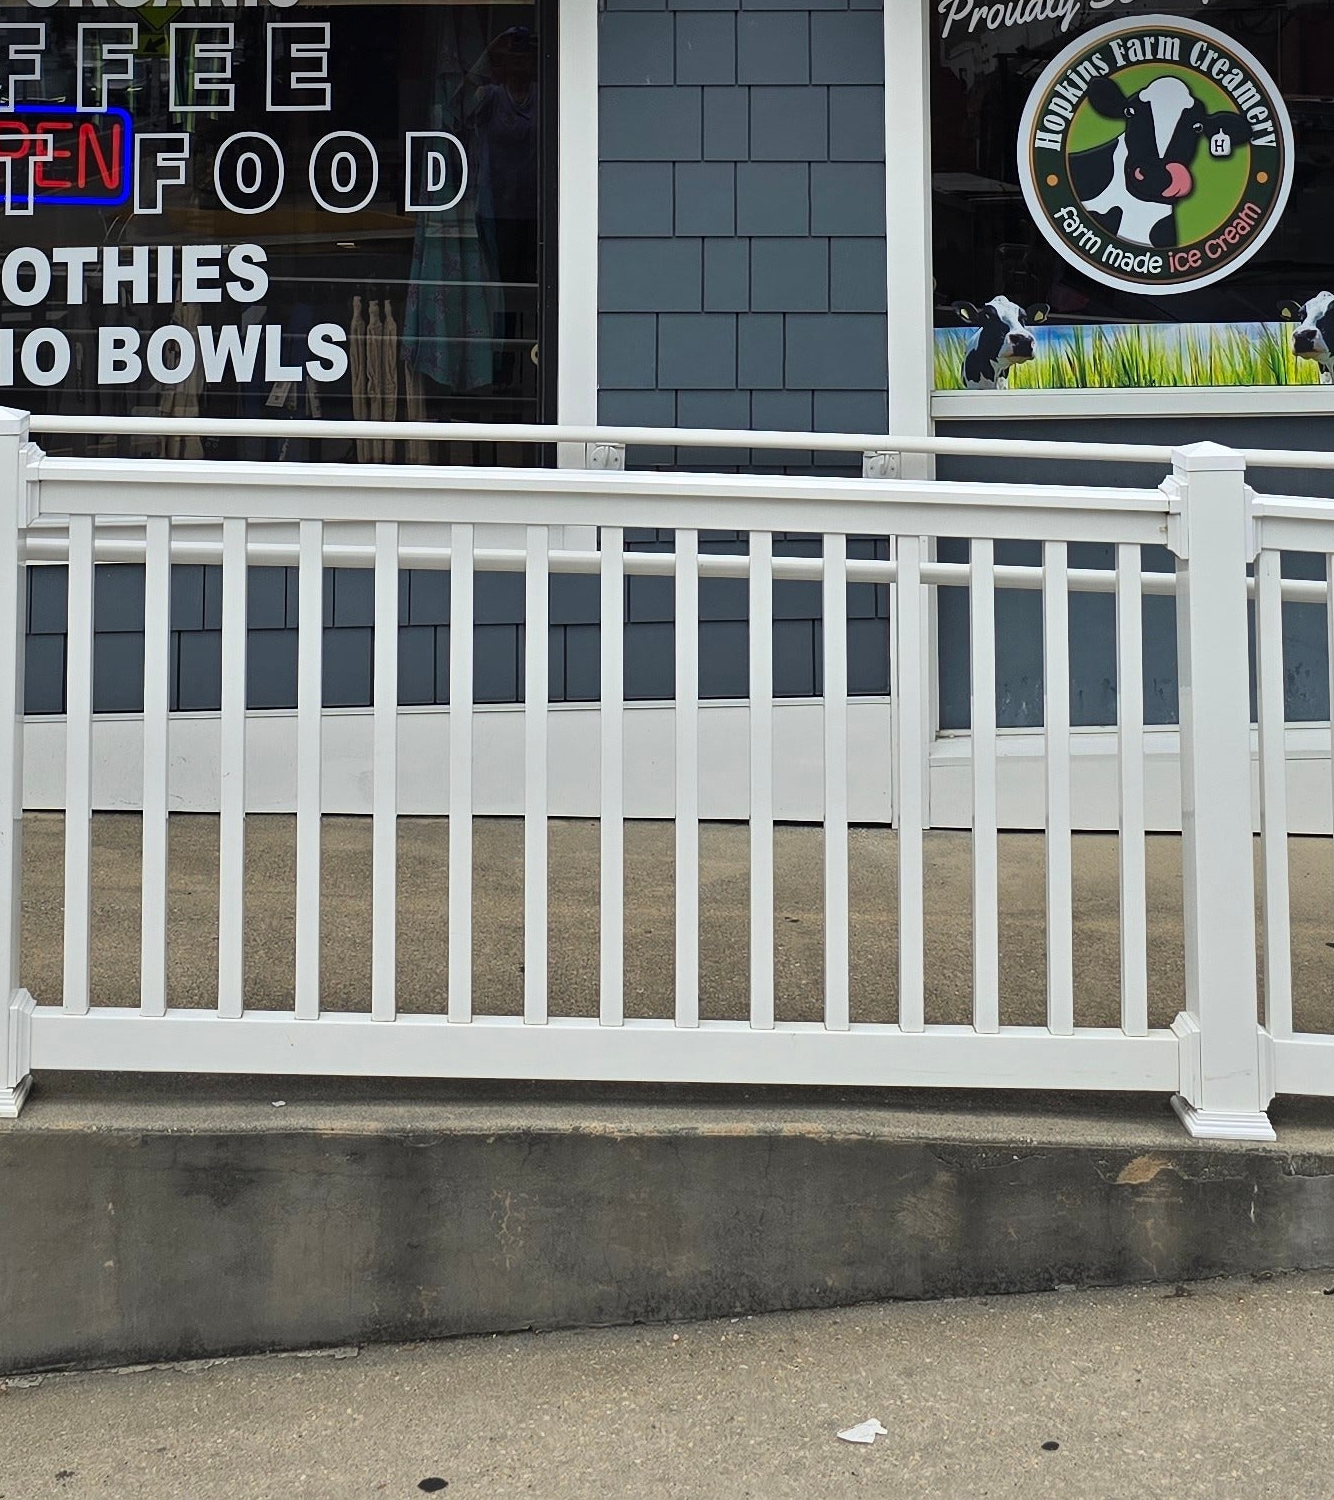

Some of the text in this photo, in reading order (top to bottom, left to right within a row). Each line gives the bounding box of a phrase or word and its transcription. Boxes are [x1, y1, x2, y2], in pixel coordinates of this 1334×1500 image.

[1035, 36, 1277, 151] Hopkins Farm Creamery
[133, 130, 468, 215] FOOD
[1101, 243, 1163, 274] made
[1169, 248, 1202, 273] ice
[1205, 202, 1262, 260] cream
[97, 323, 348, 385] BOWLS
